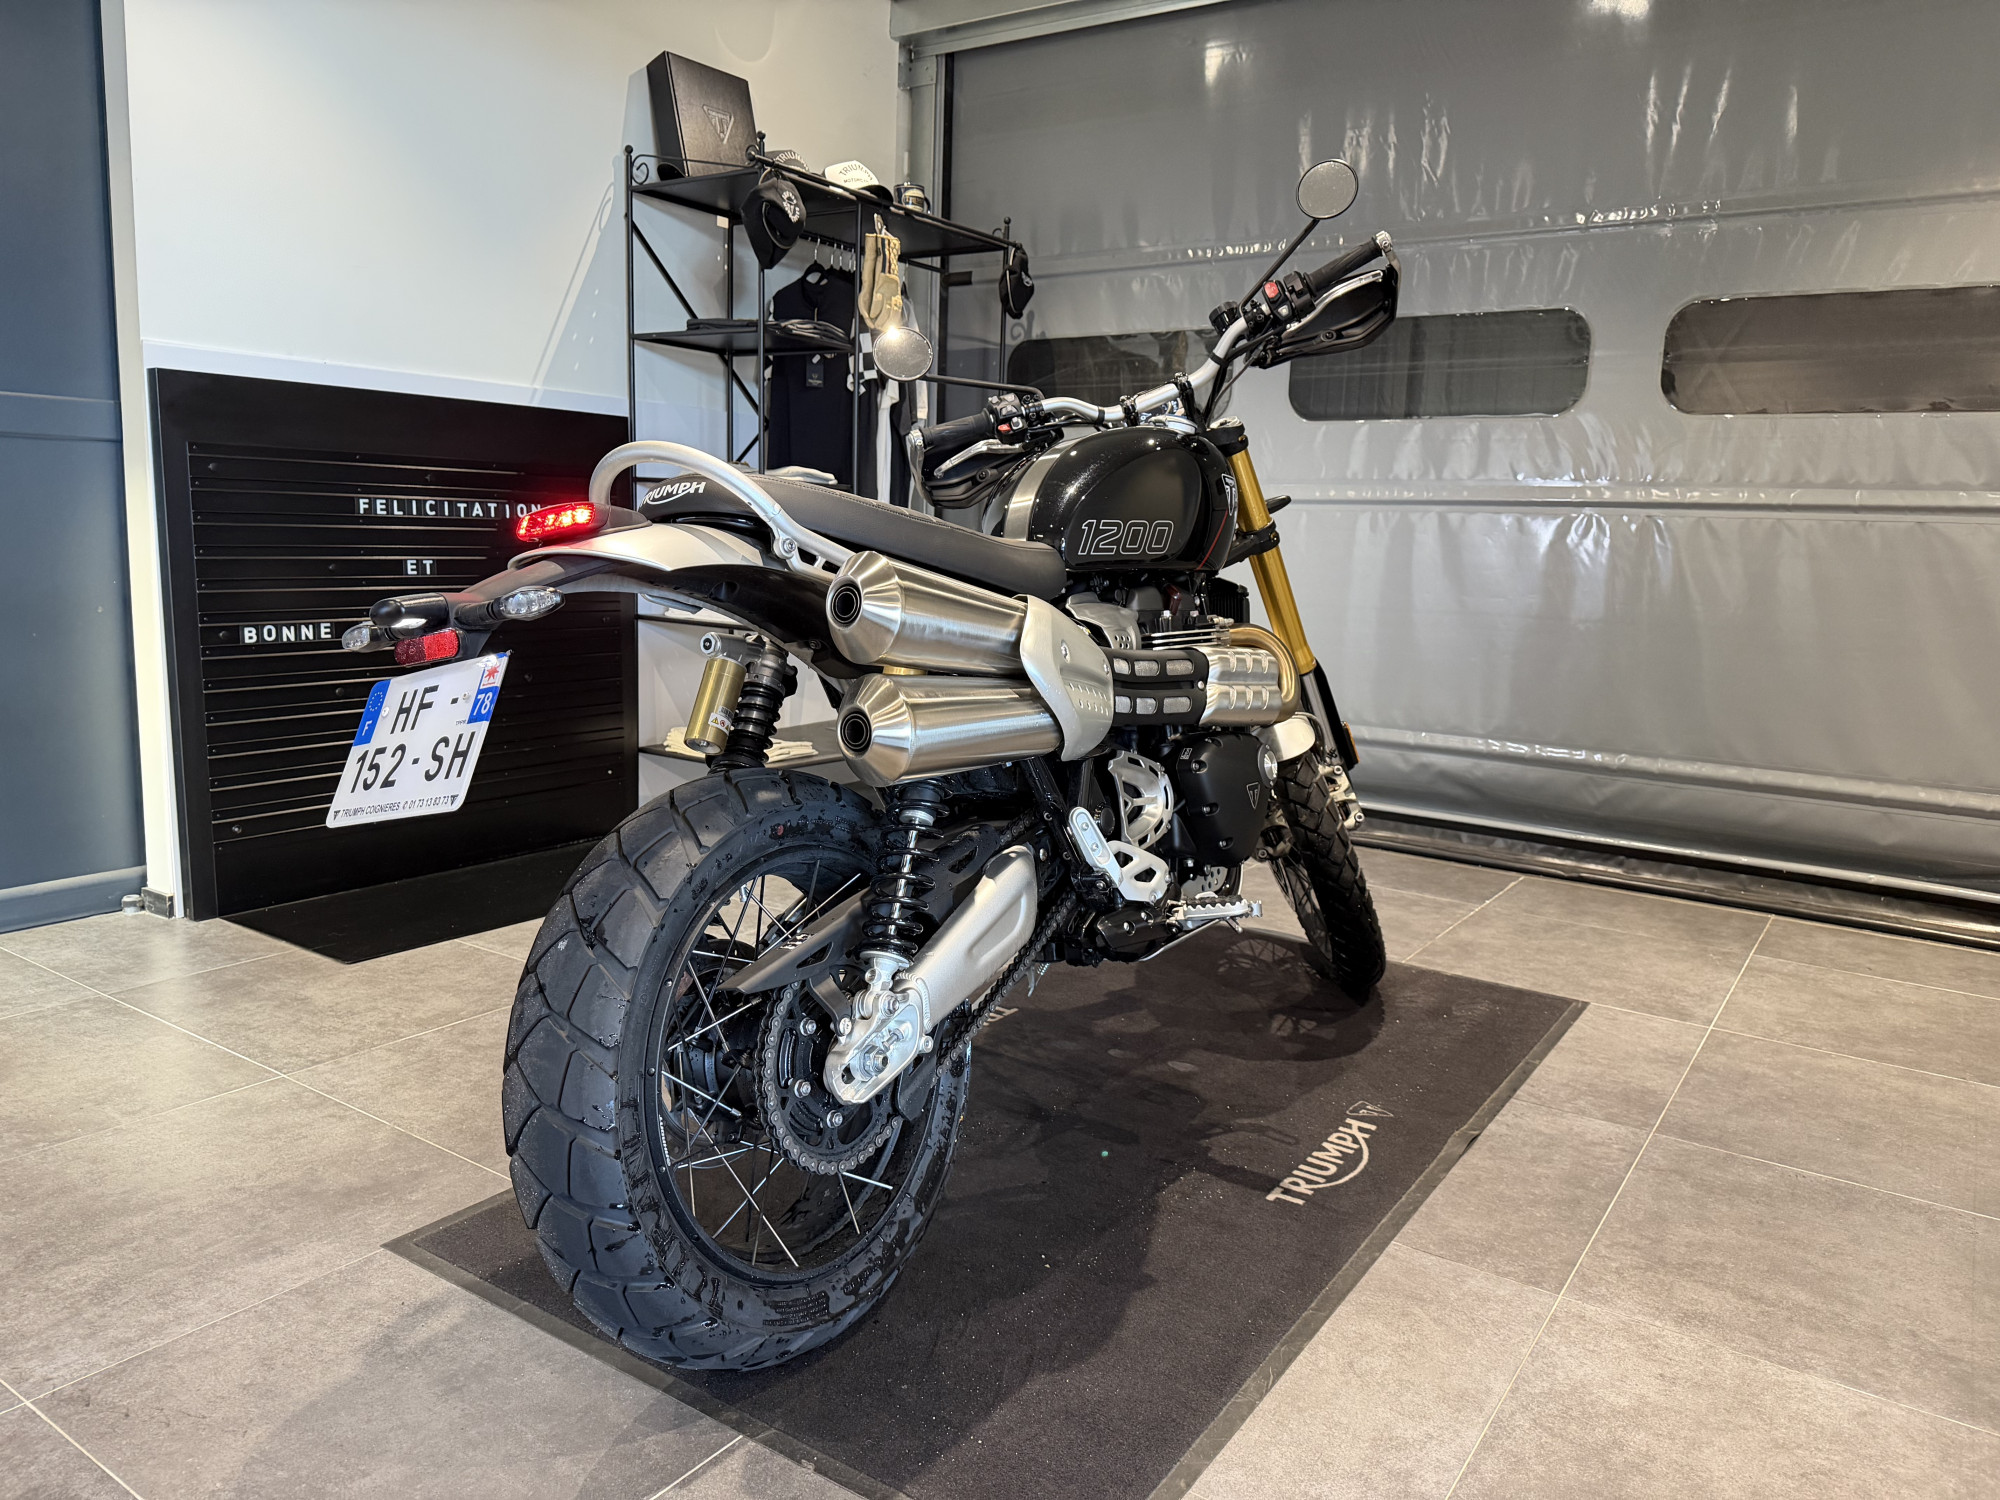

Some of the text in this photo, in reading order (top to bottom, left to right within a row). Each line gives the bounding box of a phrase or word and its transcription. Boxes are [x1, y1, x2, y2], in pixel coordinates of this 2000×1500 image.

[1078, 519, 1174, 555] 1200
[406, 559, 433, 575] ET
[243, 622, 332, 644] BONNE
[390, 685, 439, 735] HF
[473, 691, 493, 716] 78
[361, 720, 373, 737] F
[340, 807, 365, 818] TRIUMPH
[1265, 1117, 1378, 1206] TRIUMPH
